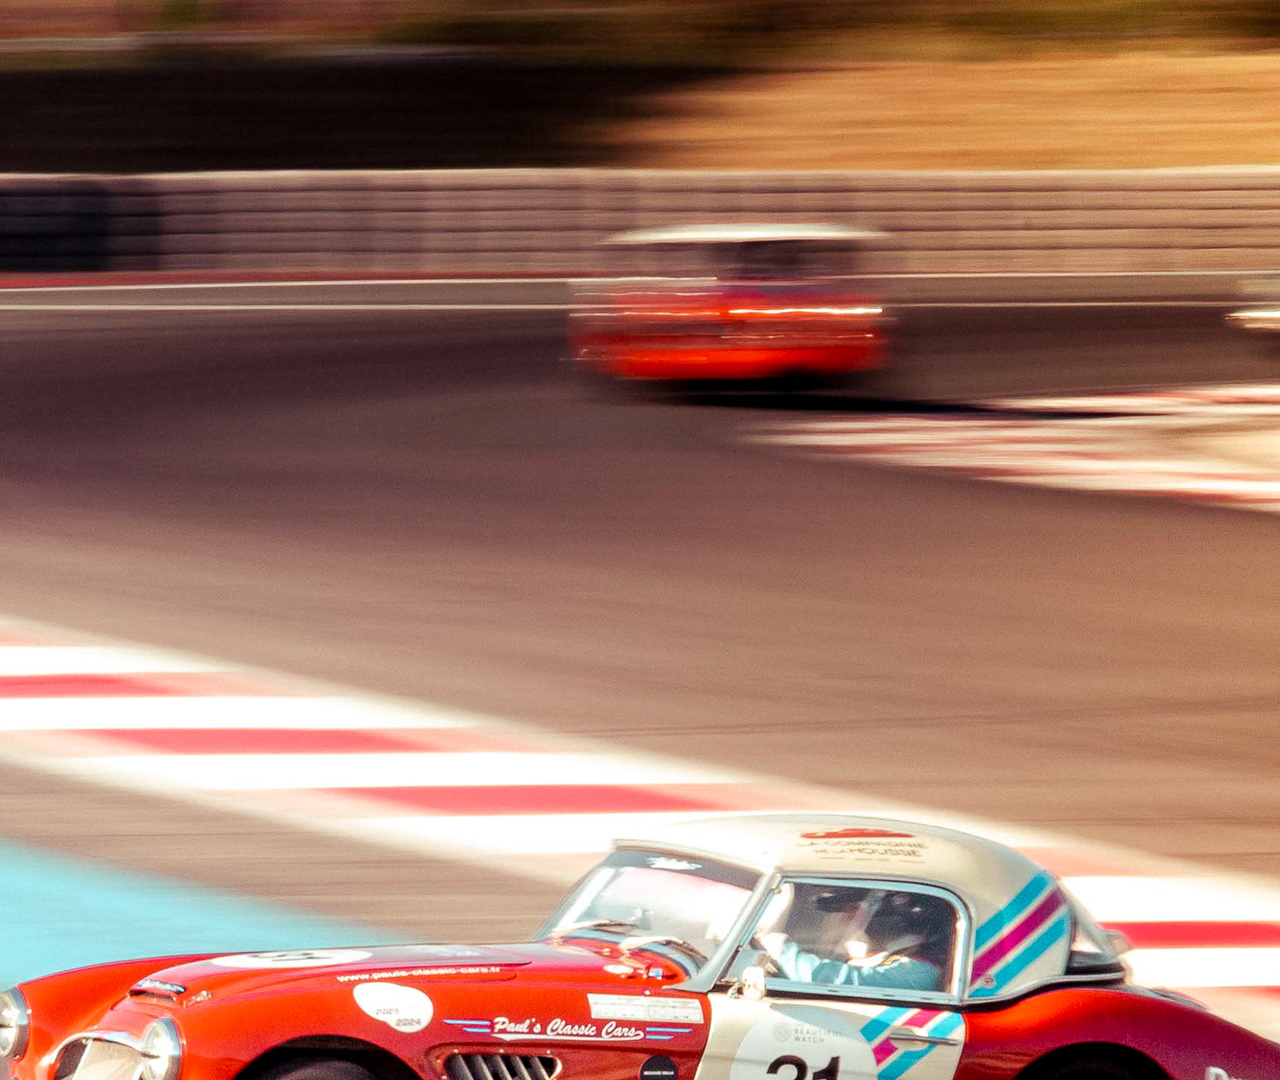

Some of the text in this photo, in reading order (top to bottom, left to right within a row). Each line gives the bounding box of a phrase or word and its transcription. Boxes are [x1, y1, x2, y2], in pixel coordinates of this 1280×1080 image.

[493, 1017, 639, 1039] Paul's Classic Cars
